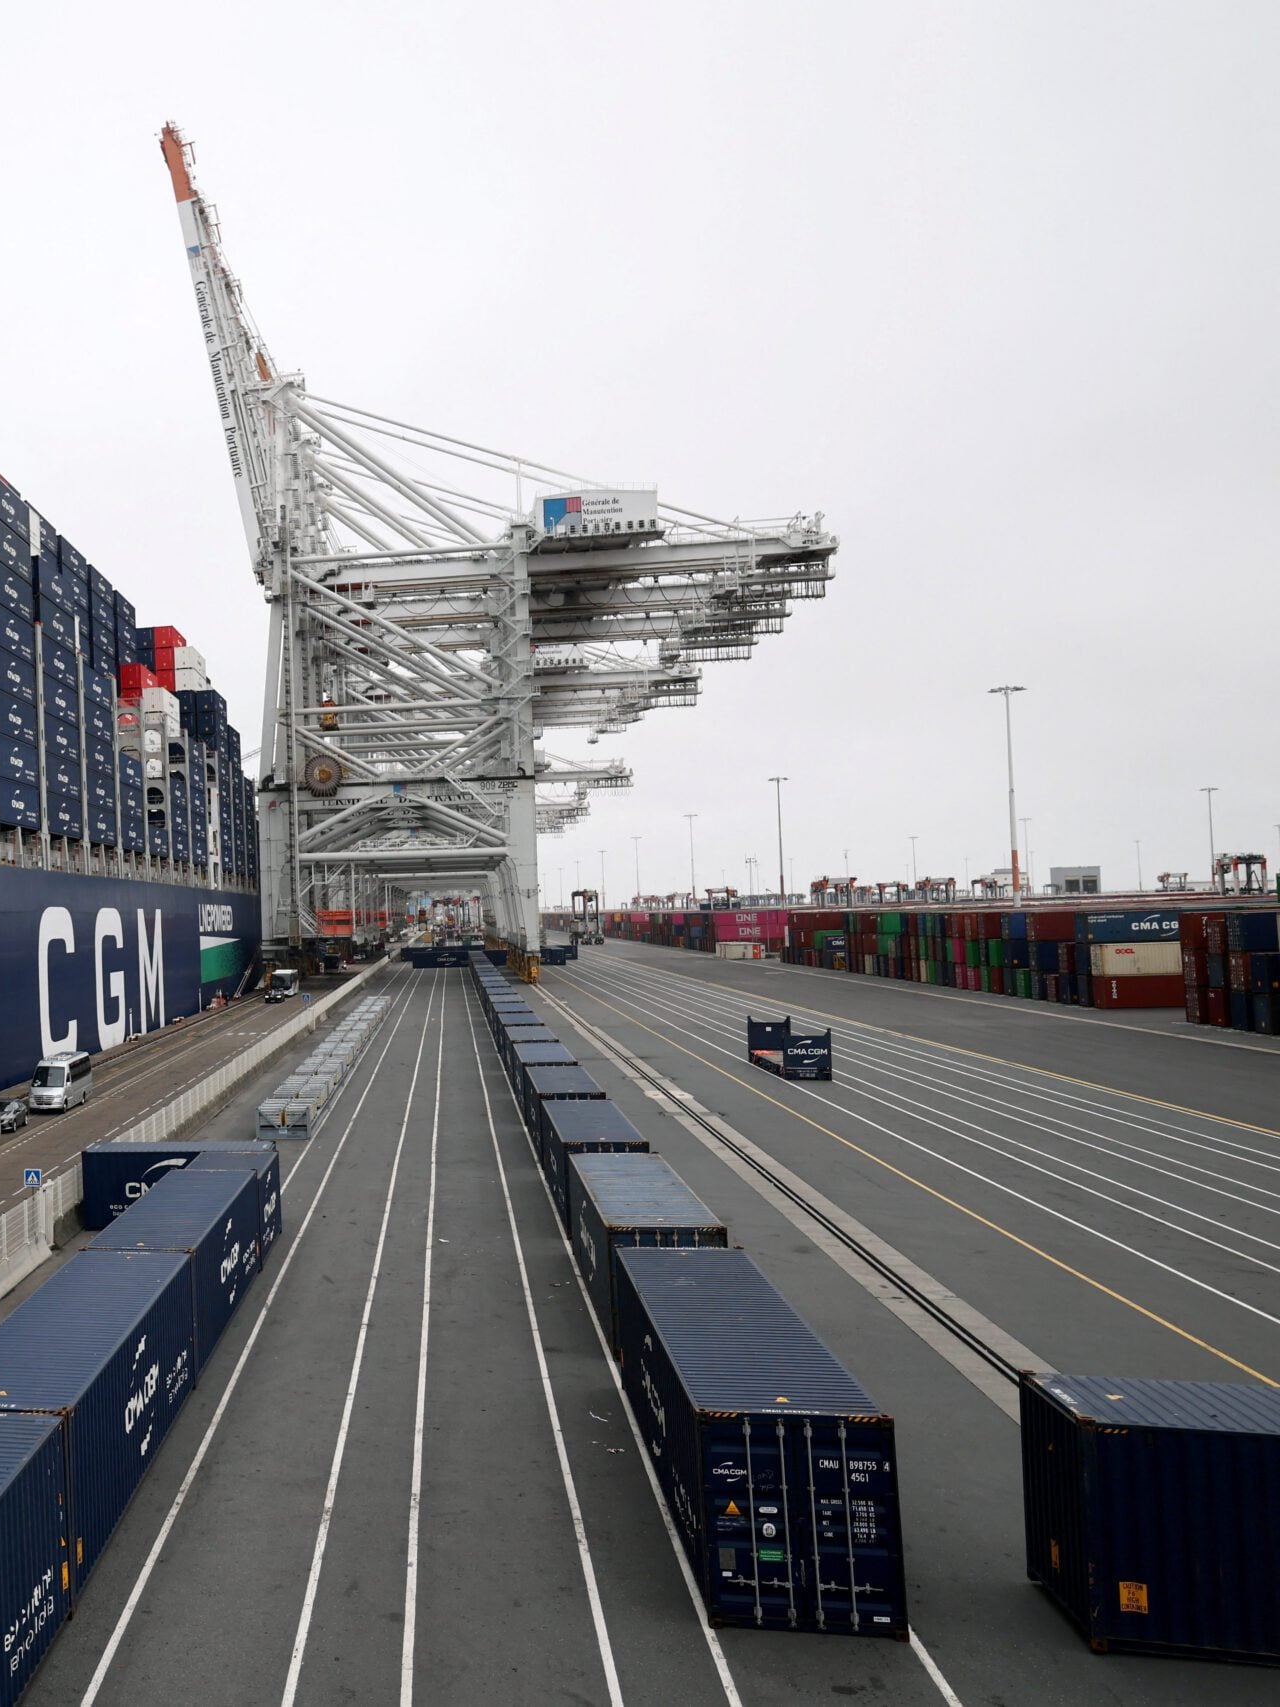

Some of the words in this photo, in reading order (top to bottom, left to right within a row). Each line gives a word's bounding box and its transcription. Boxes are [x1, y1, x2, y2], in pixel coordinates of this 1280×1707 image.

[195, 281, 214, 329] Générale
[205, 331, 216, 344] de
[210, 351, 231, 420] Manutention
[225, 426, 243, 478] Portuaire
[736, 913, 757, 922] ONE
[739, 927, 760, 935] ONE
[1131, 922, 1159, 930] CMA
[1162, 921, 1179, 929] CG
[38, 906, 165, 1059] CGM
[125, 1182, 156, 1198] CM
[819, 1459, 839, 1469] CMAU
[730, 1468, 747, 1476] CGM
[851, 1472, 869, 1483] 45G1
